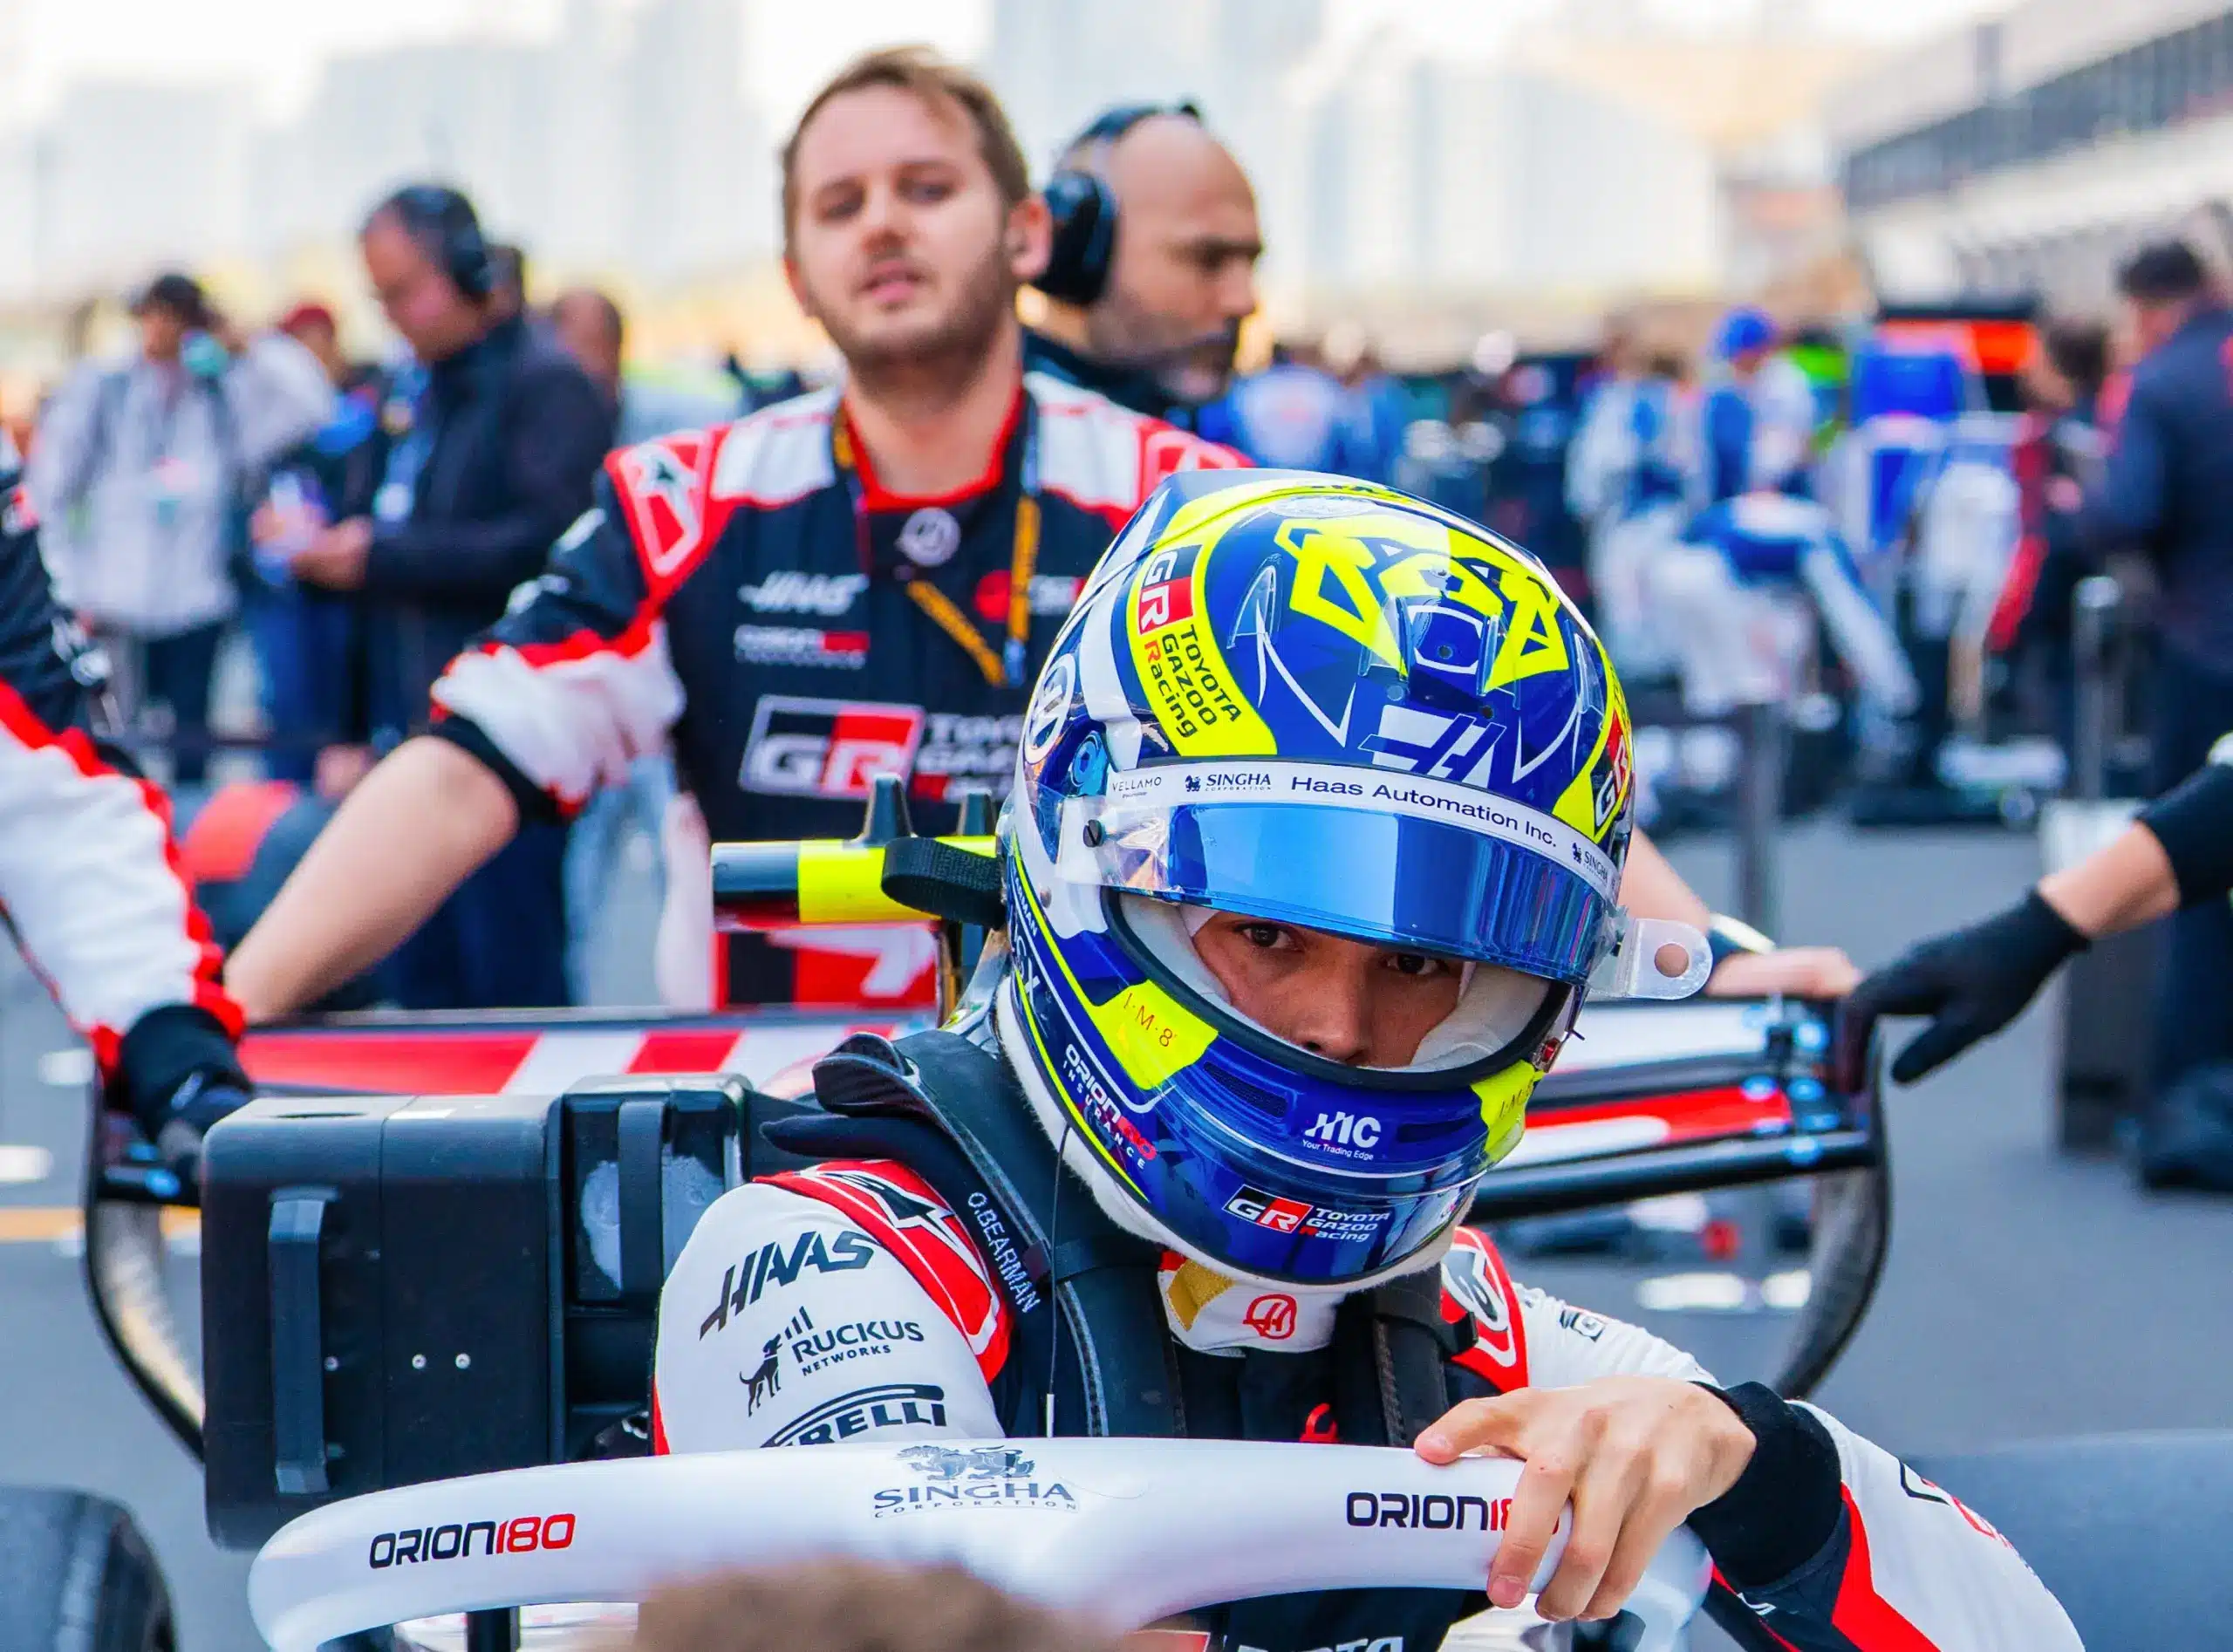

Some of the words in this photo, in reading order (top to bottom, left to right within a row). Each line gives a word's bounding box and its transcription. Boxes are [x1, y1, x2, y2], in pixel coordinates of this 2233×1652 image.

[1144, 640, 1198, 739] Racing
[1162, 632, 1218, 726] GAZOO
[1180, 624, 1242, 722] TOYOTA
[1112, 776, 1162, 792] VELLAMO
[1206, 773, 1272, 787] SINGHA
[1291, 776, 1363, 795] Haas
[1372, 784, 1518, 830] Automation
[1526, 821, 1557, 847] Inc.
[1062, 1061, 1146, 1170] INSURANCE
[1302, 1139, 1321, 1150] Your
[1322, 1143, 1352, 1158] Trading
[1354, 1150, 1374, 1161] Edge
[1306, 1218, 1378, 1232] GAZOO
[1315, 1208, 1391, 1221] TOYOTA
[967, 1191, 1041, 1314] O.BEARMAN
[1299, 1226, 1370, 1243] Racing
[700, 1230, 881, 1341] HAAS
[791, 1321, 925, 1363] RUCKUS
[802, 1344, 891, 1376] NETWORKS
[873, 1483, 1075, 1510] SINGHA
[874, 1499, 1077, 1519] CORPORATION
[369, 1513, 577, 1569] ORION180
